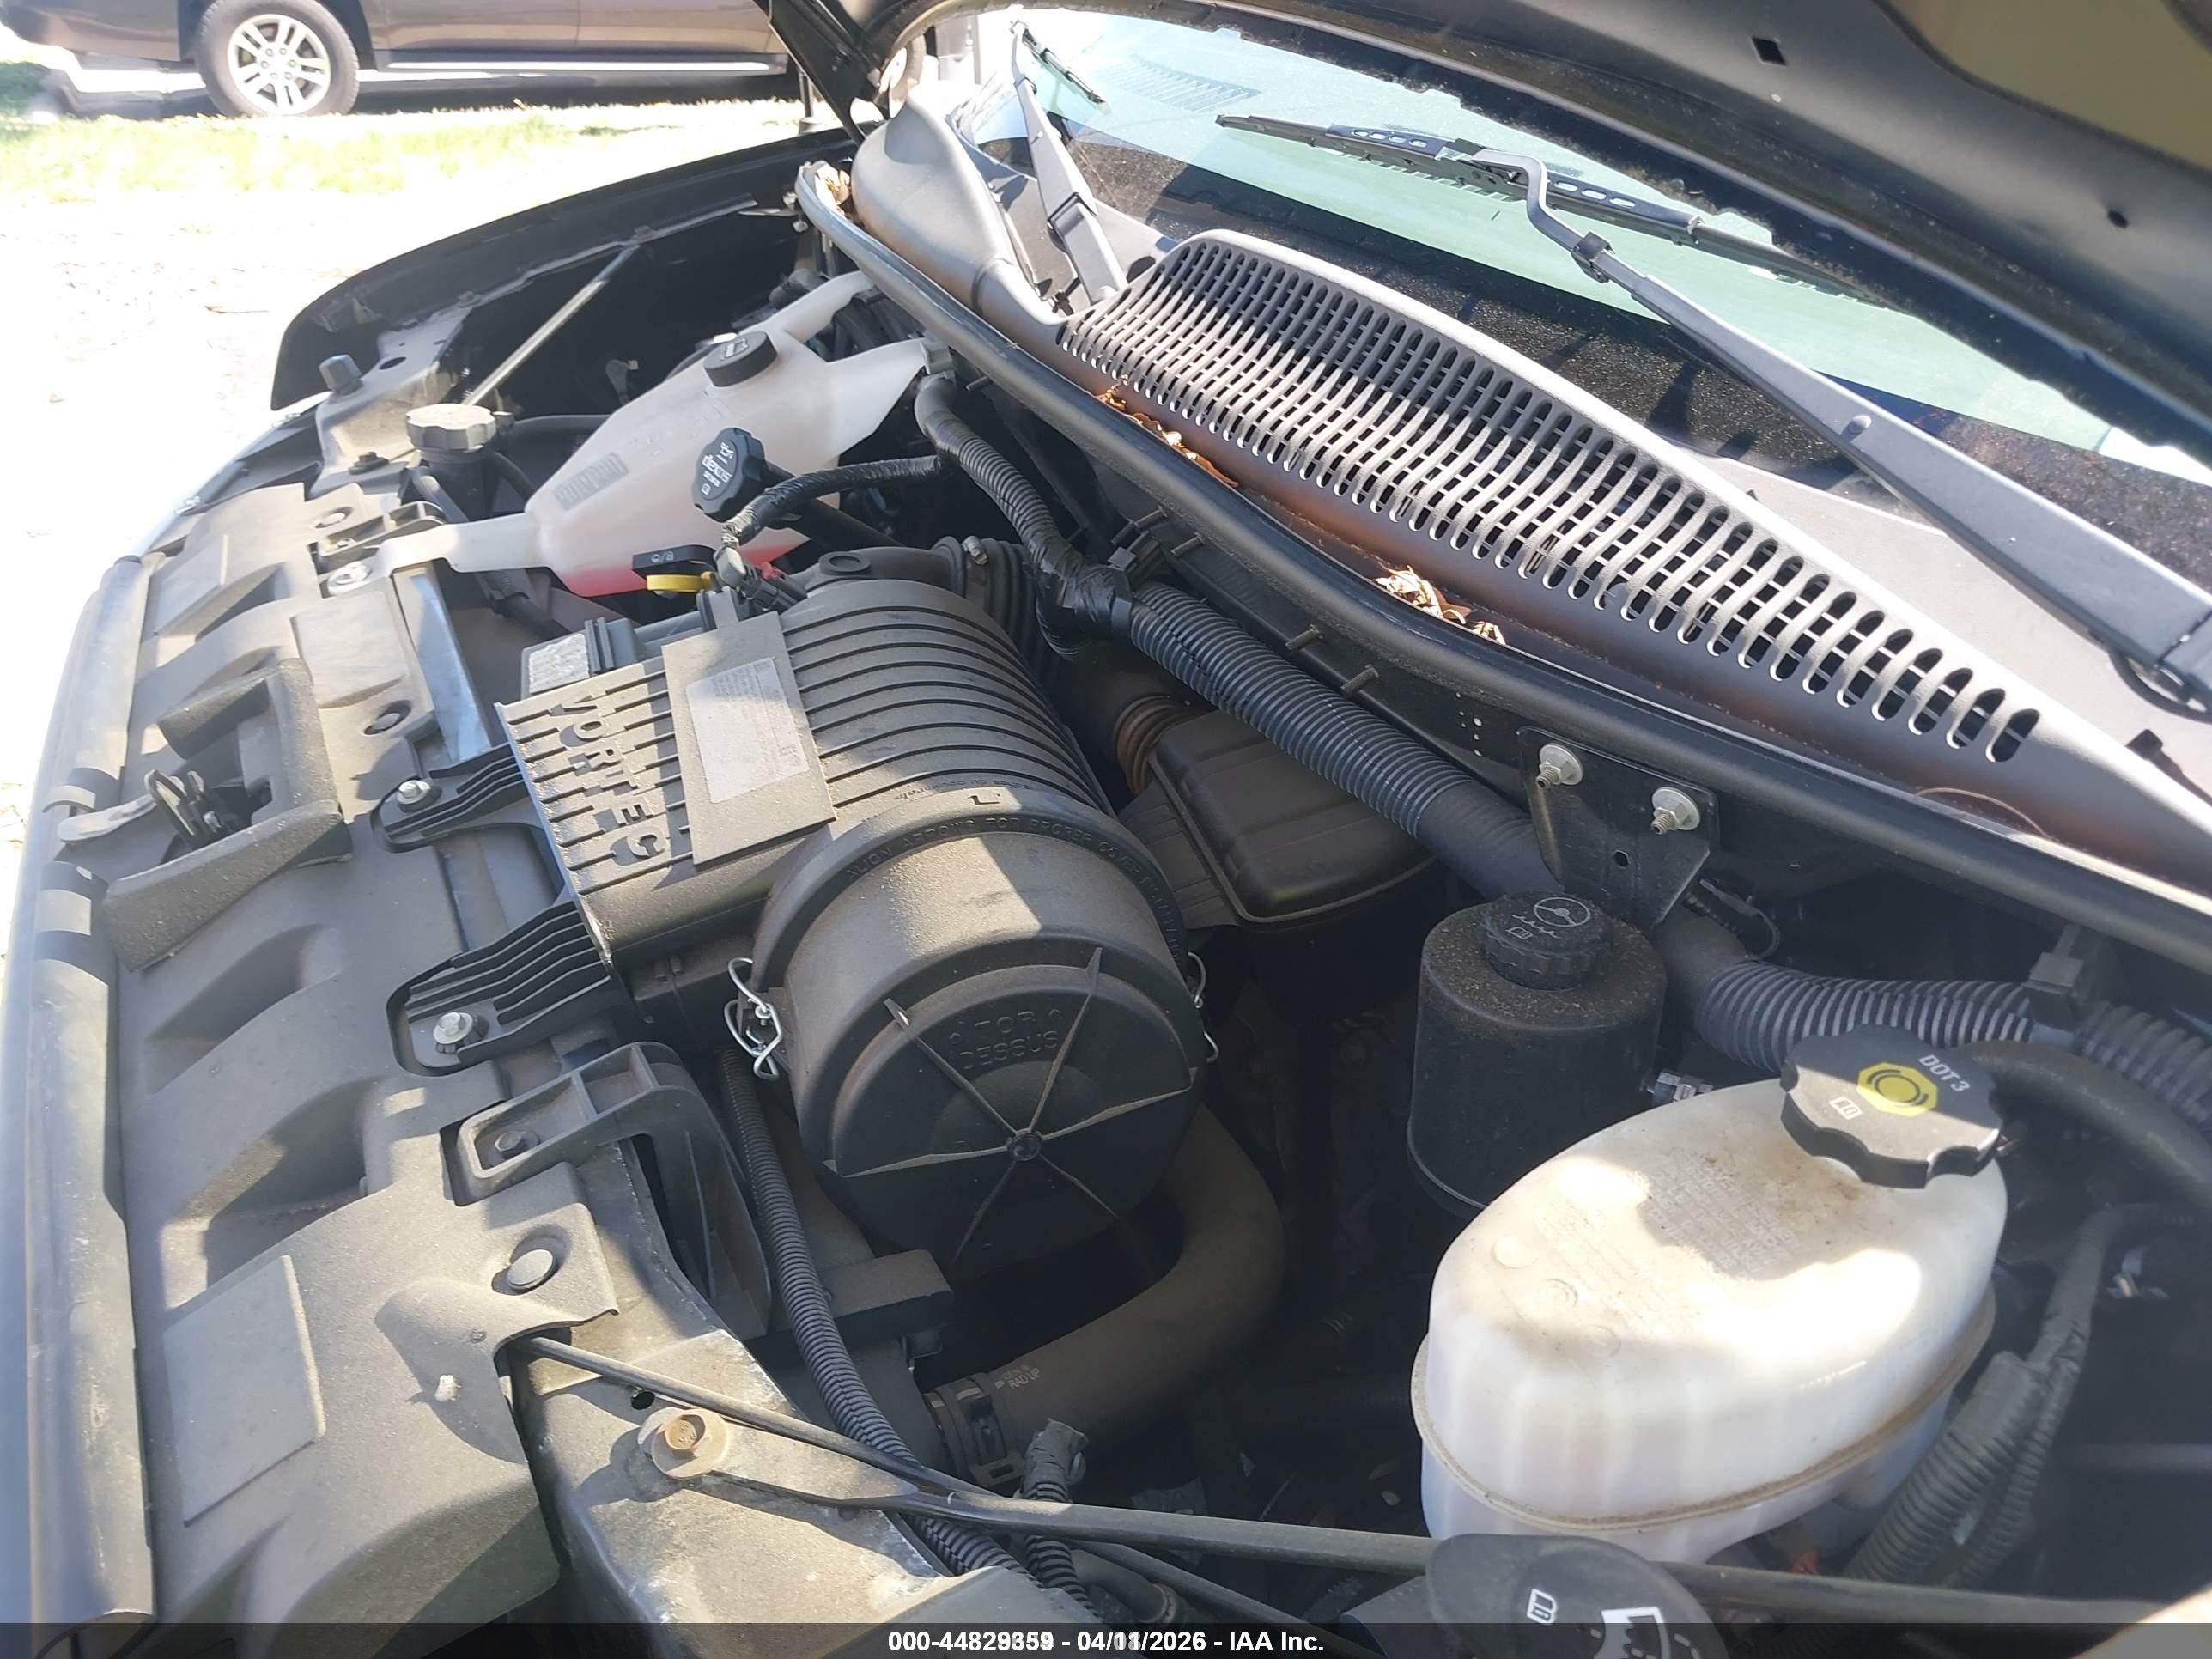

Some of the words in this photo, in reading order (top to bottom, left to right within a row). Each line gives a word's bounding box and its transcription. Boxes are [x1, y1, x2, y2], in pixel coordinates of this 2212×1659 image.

[562, 693, 665, 859] VORTEC
[1918, 1054, 1960, 1081] DOT
[1950, 1080, 1971, 1092] 3
